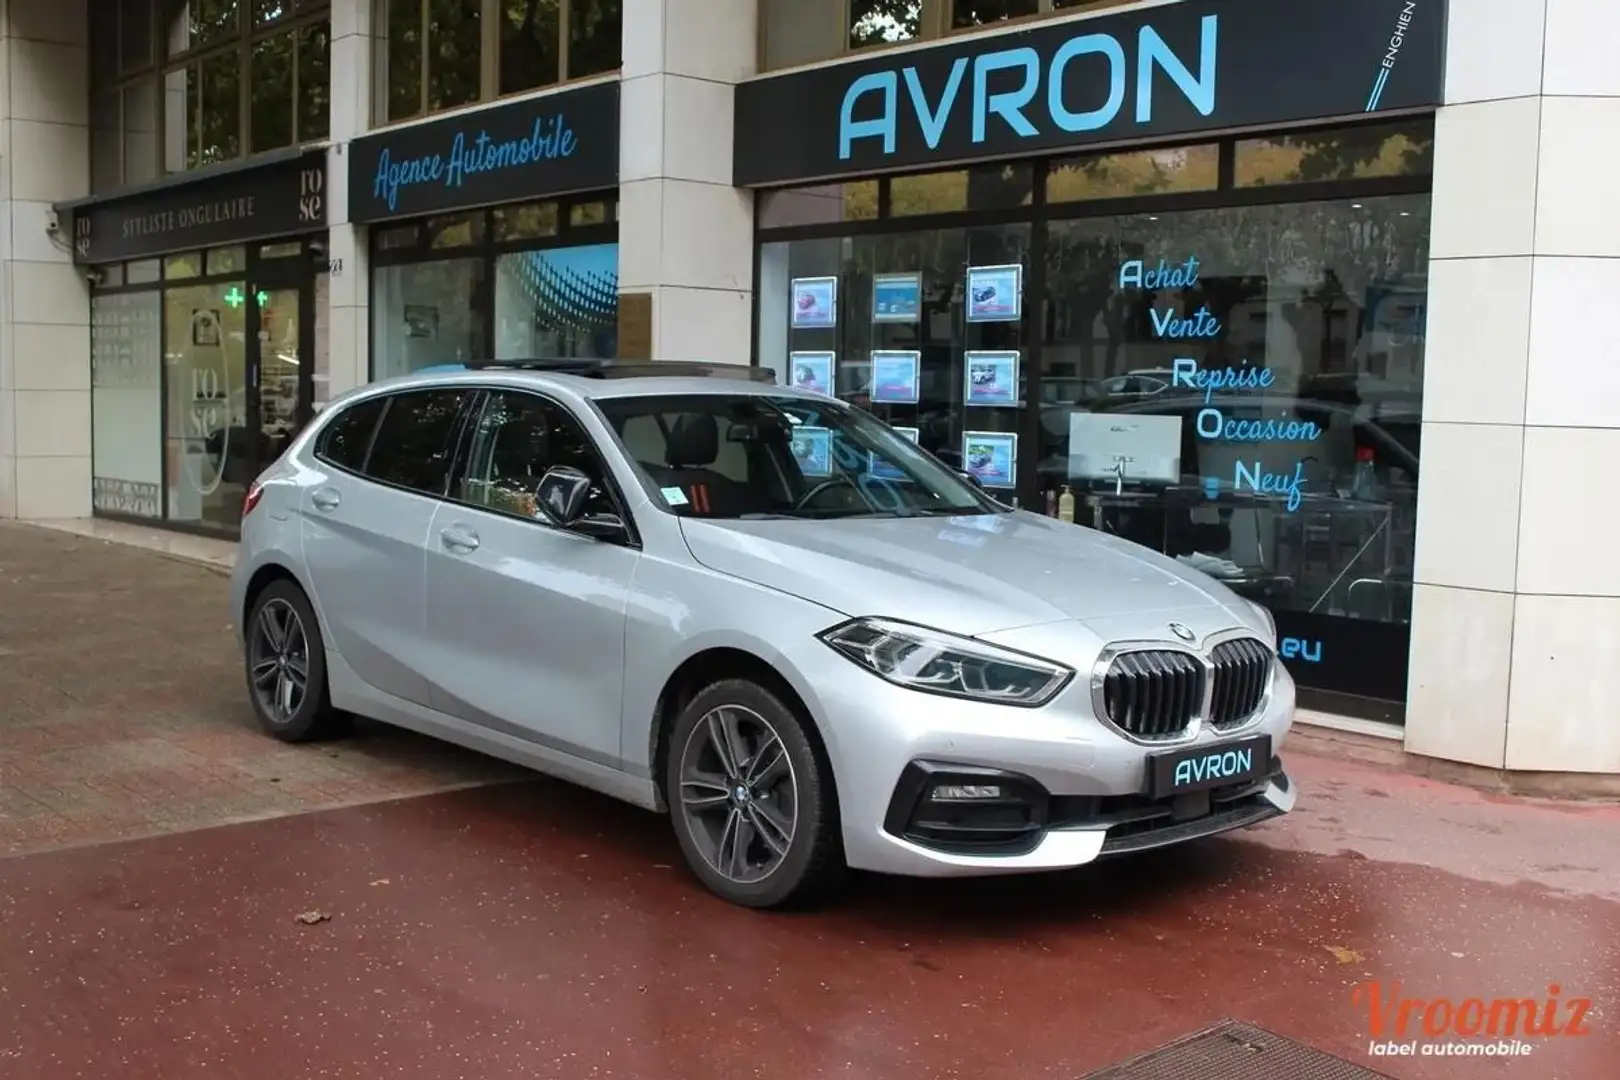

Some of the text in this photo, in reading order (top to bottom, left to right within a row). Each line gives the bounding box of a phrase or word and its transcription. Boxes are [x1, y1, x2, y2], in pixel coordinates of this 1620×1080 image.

[1382, 1, 1416, 68] ENGHIEN
[838, 15, 1218, 160] AVRON
[374, 113, 578, 212] Agence Automobile
[179, 197, 255, 228] ONGULAIRE
[1119, 256, 1200, 289] Achat
[1150, 306, 1222, 337] Vente
[1172, 358, 1276, 404] Reprise
[1196, 408, 1322, 440] Occasion
[1234, 460, 1308, 511] Neuf
[1174, 748, 1252, 786] AVRON
